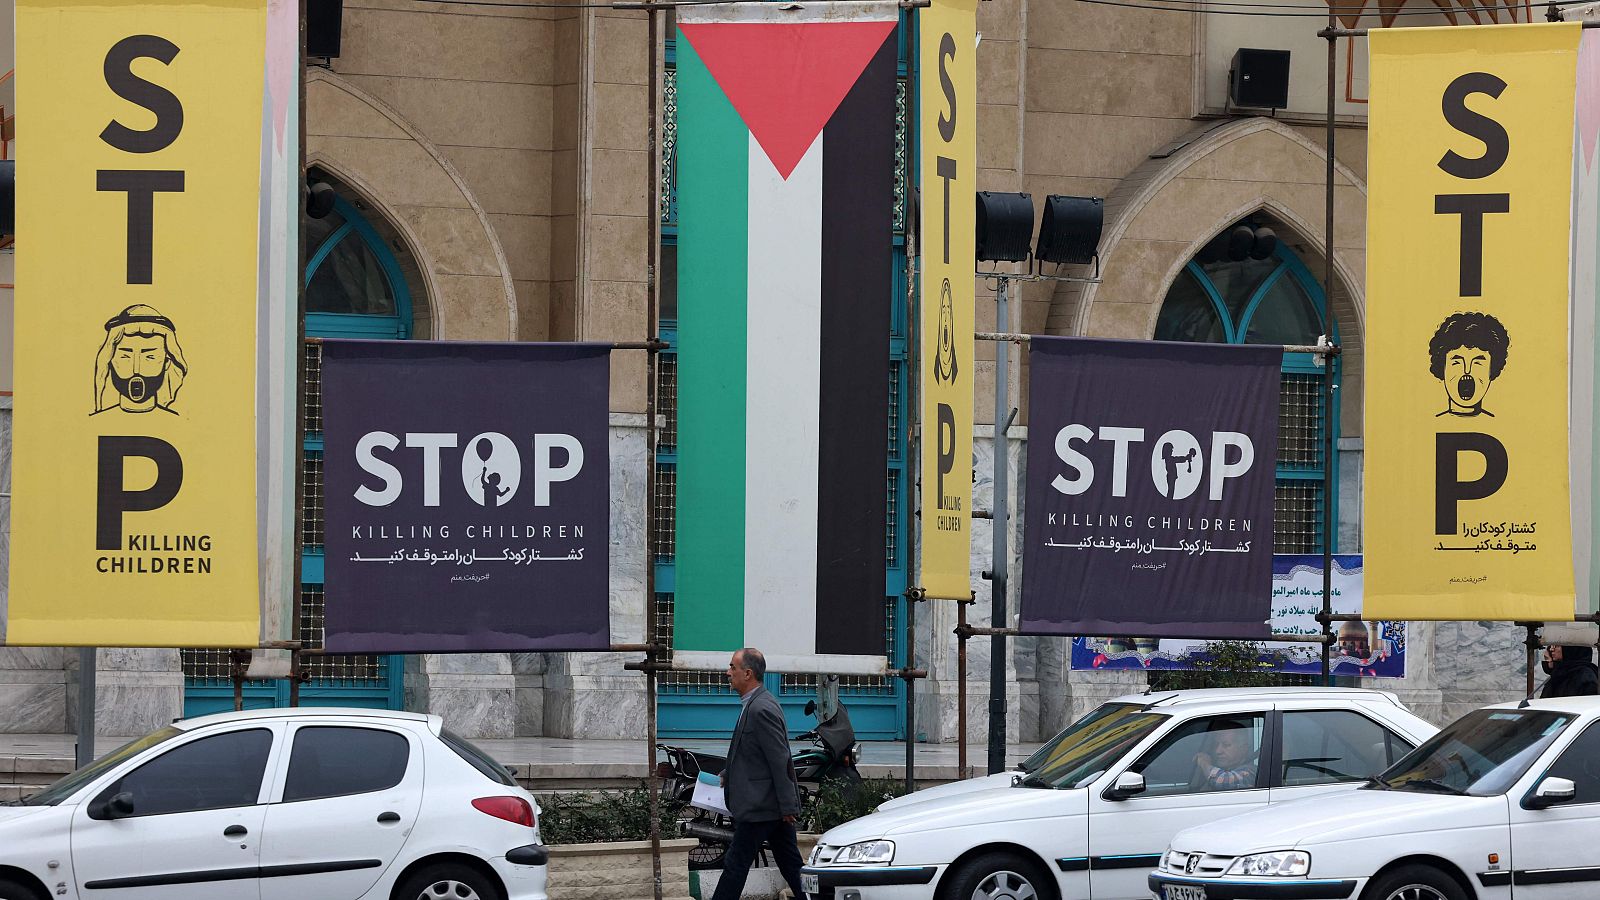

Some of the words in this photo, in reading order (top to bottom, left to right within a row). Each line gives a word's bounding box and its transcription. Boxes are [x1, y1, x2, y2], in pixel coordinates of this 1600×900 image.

[937, 32, 957, 510] STP
[95, 34, 186, 551] STP
[1433, 71, 1511, 535] STP
[353, 431, 584, 507] STOP
[1050, 423, 1255, 501] STOP
[944, 495, 961, 511] KILLING
[937, 515, 961, 531] CHILDREN
[1048, 512, 1133, 528] KILLING
[1147, 516, 1252, 532] CHILDREN
[1470, 522, 1506, 537] کودکان
[1506, 522, 1537, 537] کشتار
[352, 525, 450, 539] KILLING
[466, 525, 584, 539] CHILDREN
[128, 535, 212, 552] KILLING
[1490, 539, 1537, 554] متوقف
[96, 557, 212, 574] CHILDREN
[1299, 586, 1311, 596] ماه
[1330, 587, 1341, 596] ماه
[1277, 605, 1288, 617] نور
[1288, 605, 1306, 617] میلاد
